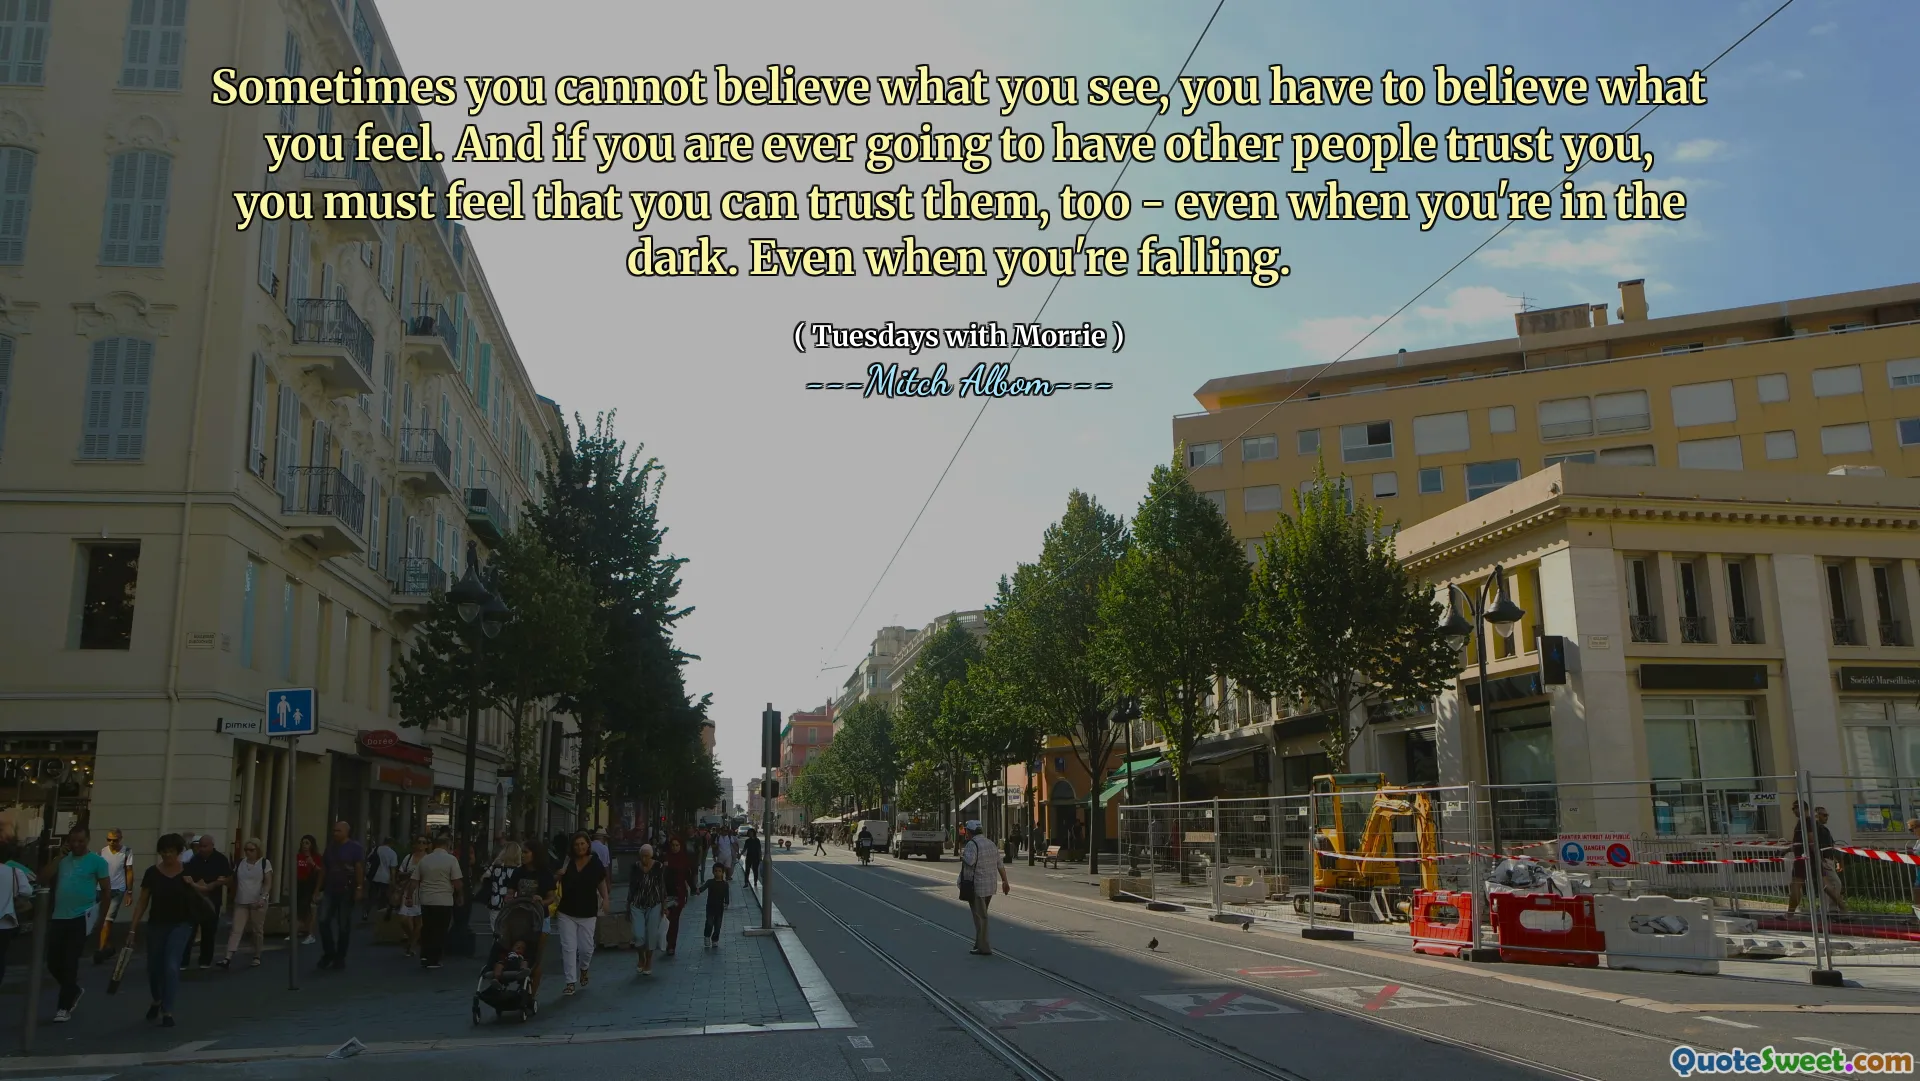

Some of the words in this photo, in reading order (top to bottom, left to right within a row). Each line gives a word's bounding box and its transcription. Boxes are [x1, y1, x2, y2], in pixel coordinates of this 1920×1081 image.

[1850, 675, 1875, 684] Société
[1875, 675, 1917, 684] Marseillaise
[225, 722, 257, 730] pimkie
[367, 737, 393, 745] Dorée
